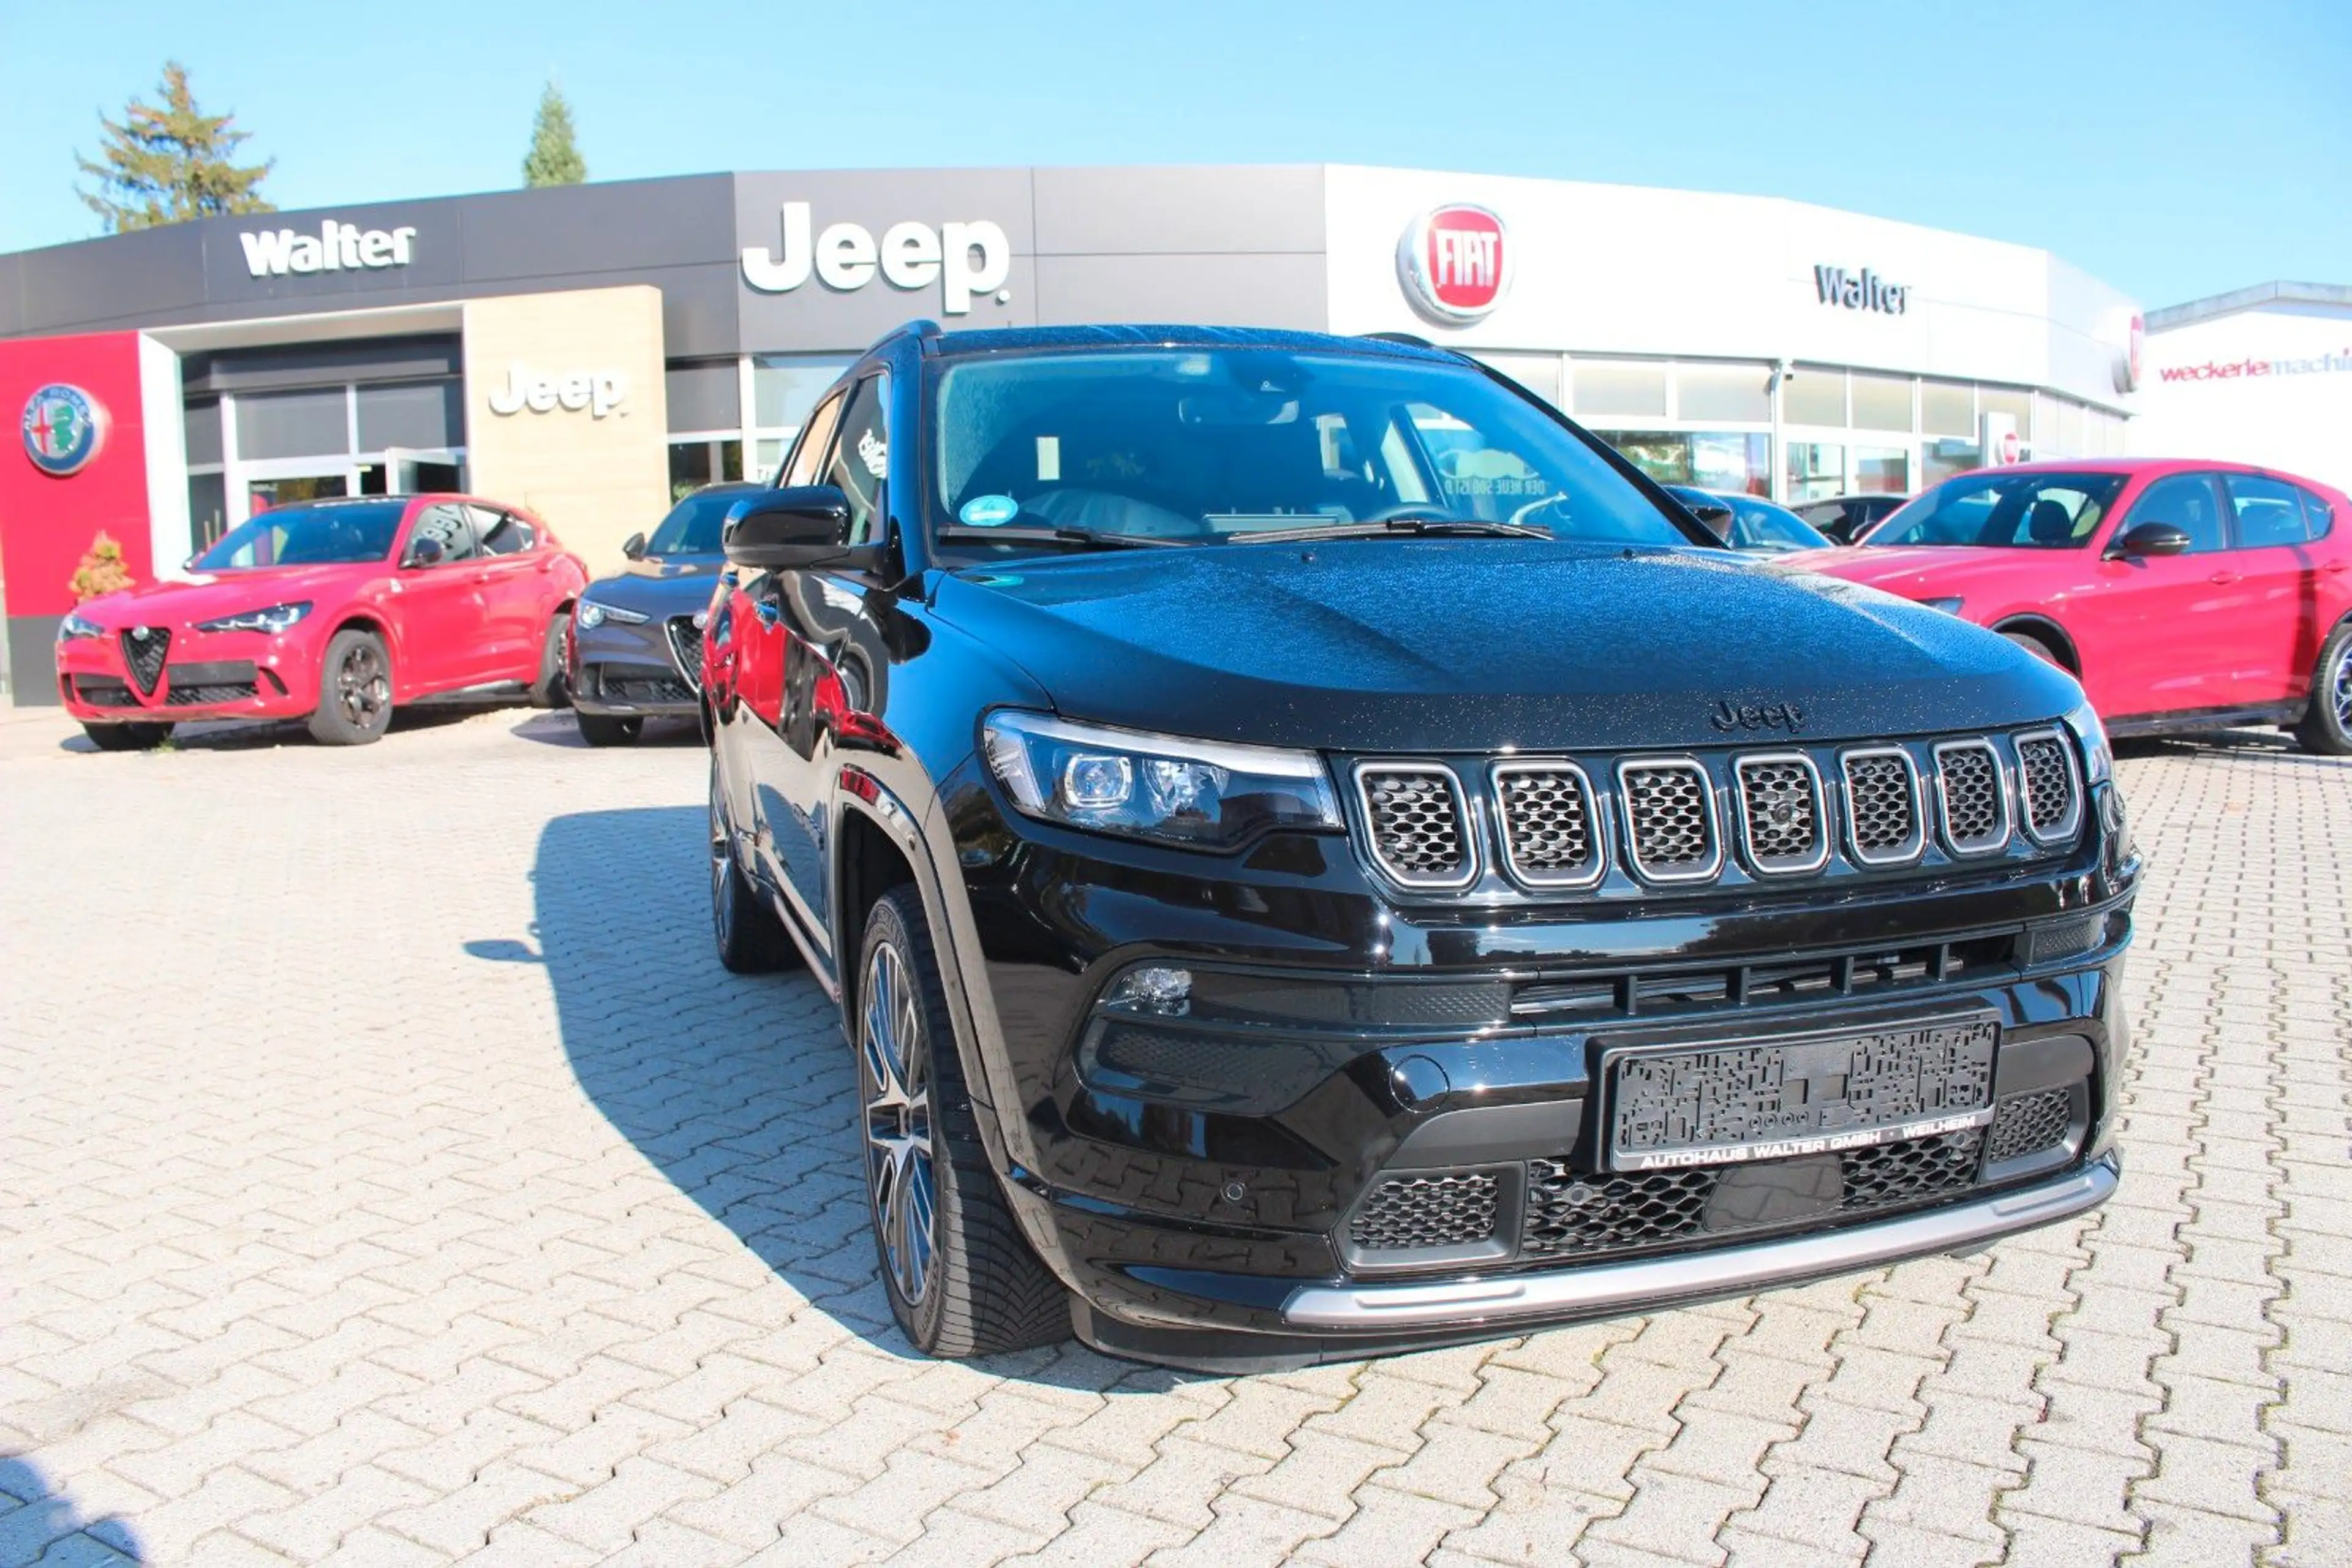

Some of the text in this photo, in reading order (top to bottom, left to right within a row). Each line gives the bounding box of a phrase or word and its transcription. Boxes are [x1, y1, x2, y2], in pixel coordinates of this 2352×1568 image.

[239, 219, 417, 276] Walter
[1435, 228, 1499, 287] FIAT
[1814, 265, 1913, 316] Walter
[489, 360, 628, 418] Jeep
[1711, 701, 1806, 734] Jeep
[1640, 1147, 1748, 1169] AUTOHAUS
[1753, 1139, 1825, 1159] WALTER
[1902, 1115, 1977, 1138] WEILHEIM
